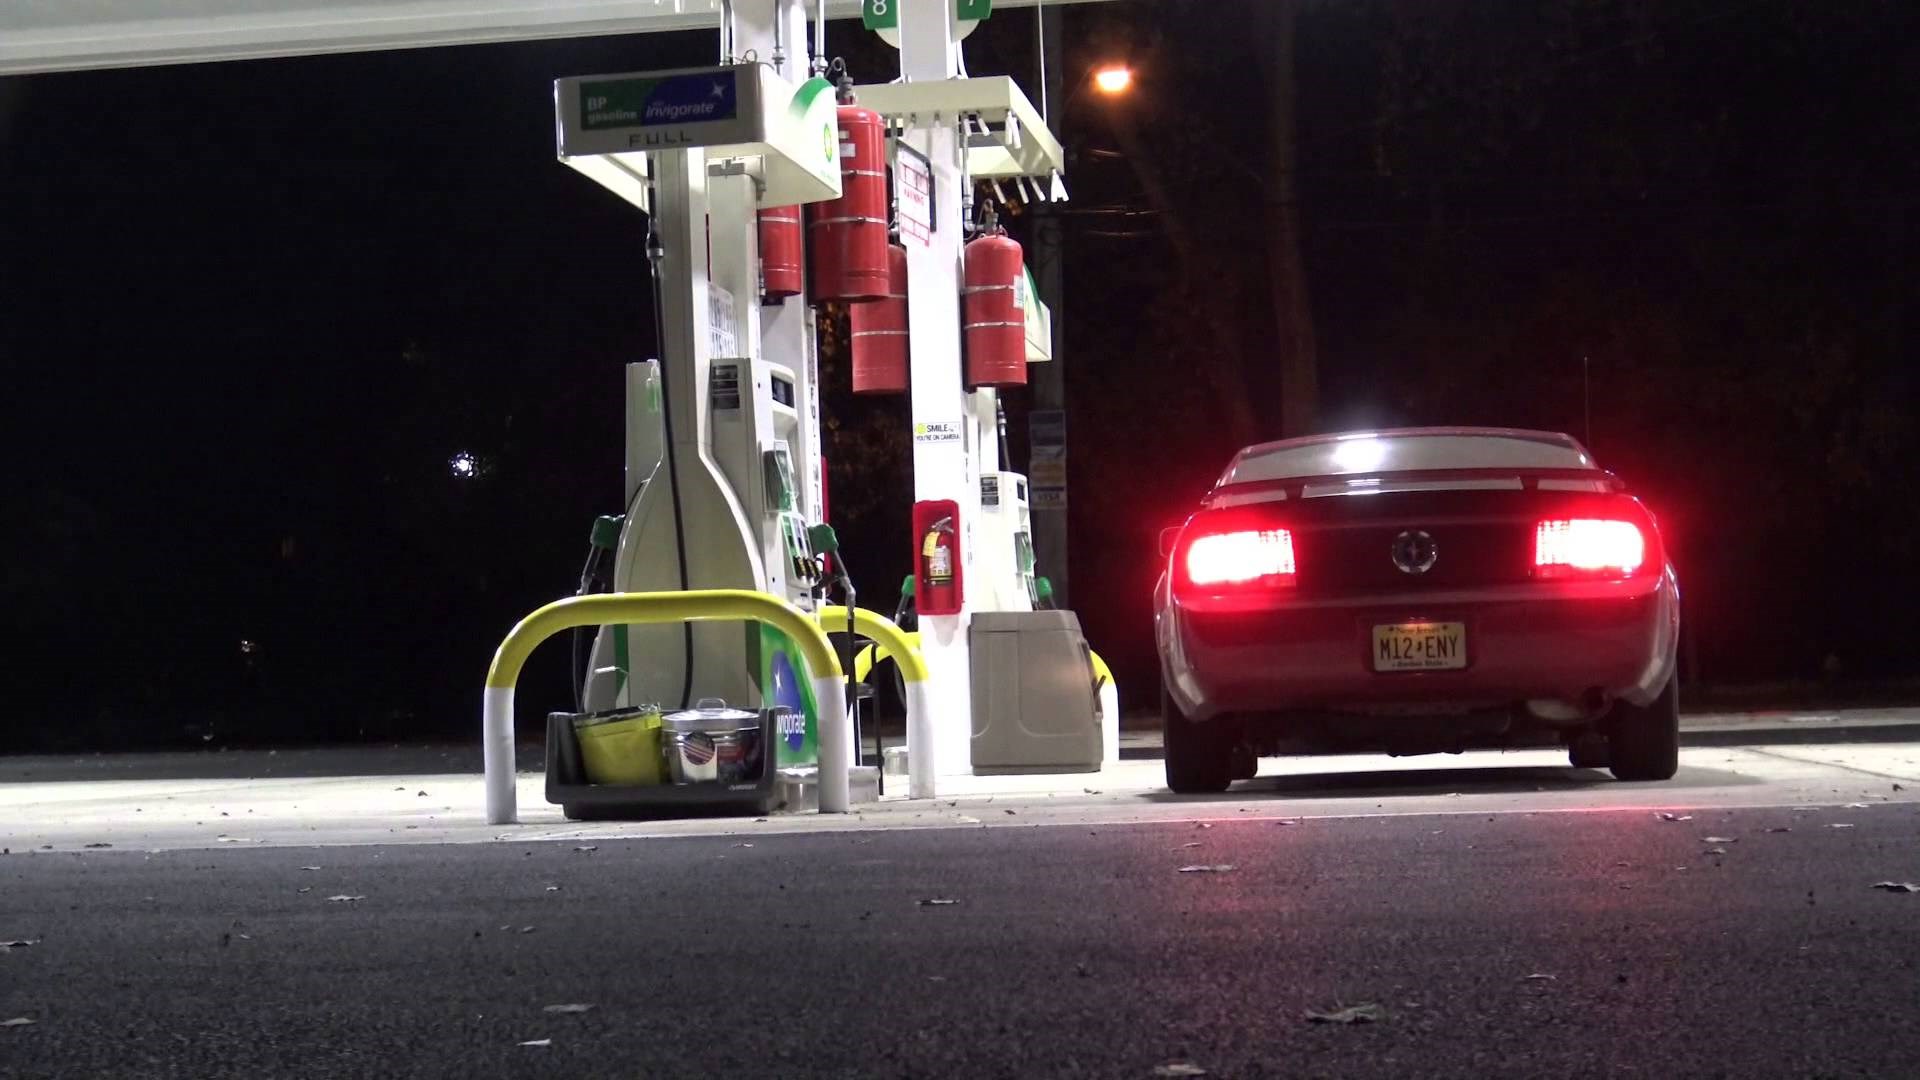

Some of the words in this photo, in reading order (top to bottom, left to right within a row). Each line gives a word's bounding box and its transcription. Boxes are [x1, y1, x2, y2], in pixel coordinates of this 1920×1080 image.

[873, 0, 887, 15] 8
[588, 96, 607, 111] BP
[646, 102, 715, 119] invigorate
[588, 109, 638, 124] gasoline
[629, 130, 693, 147] FULL
